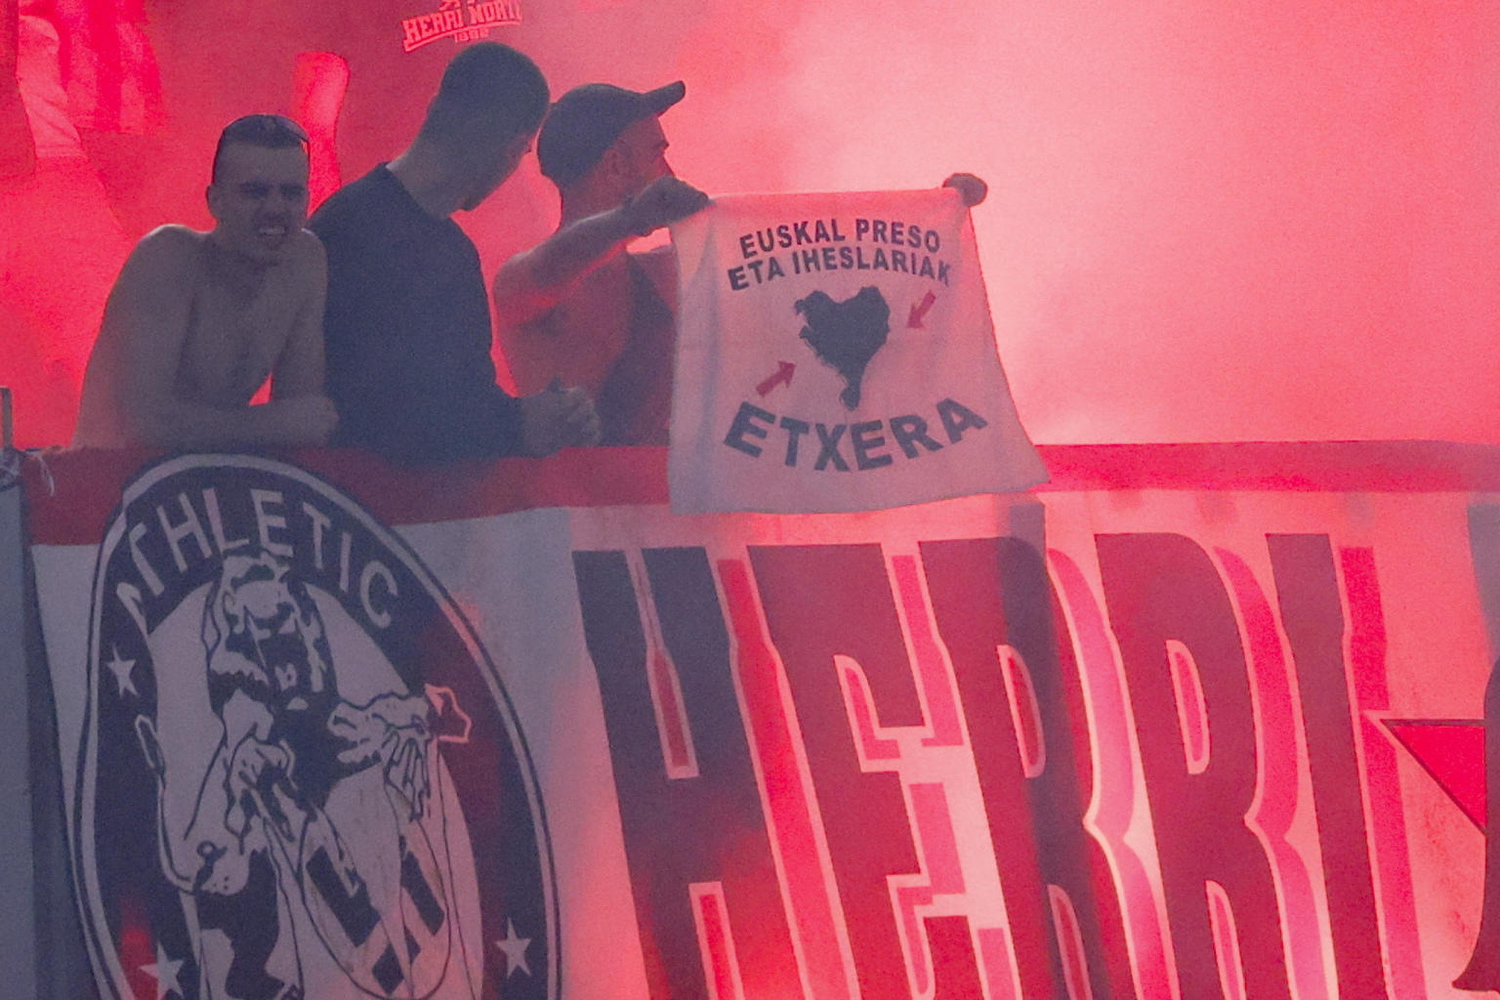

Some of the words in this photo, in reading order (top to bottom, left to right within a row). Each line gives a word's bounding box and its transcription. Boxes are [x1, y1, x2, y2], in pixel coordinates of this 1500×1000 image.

[402, 9, 463, 43] HERRI
[739, 219, 846, 260] EUSKAL
[855, 219, 941, 254] PRESO
[728, 257, 785, 291] ETA
[792, 247, 951, 287] IHESLARIAK
[723, 398, 989, 472] ETXERA
[572, 532, 1390, 1000] HERRI
